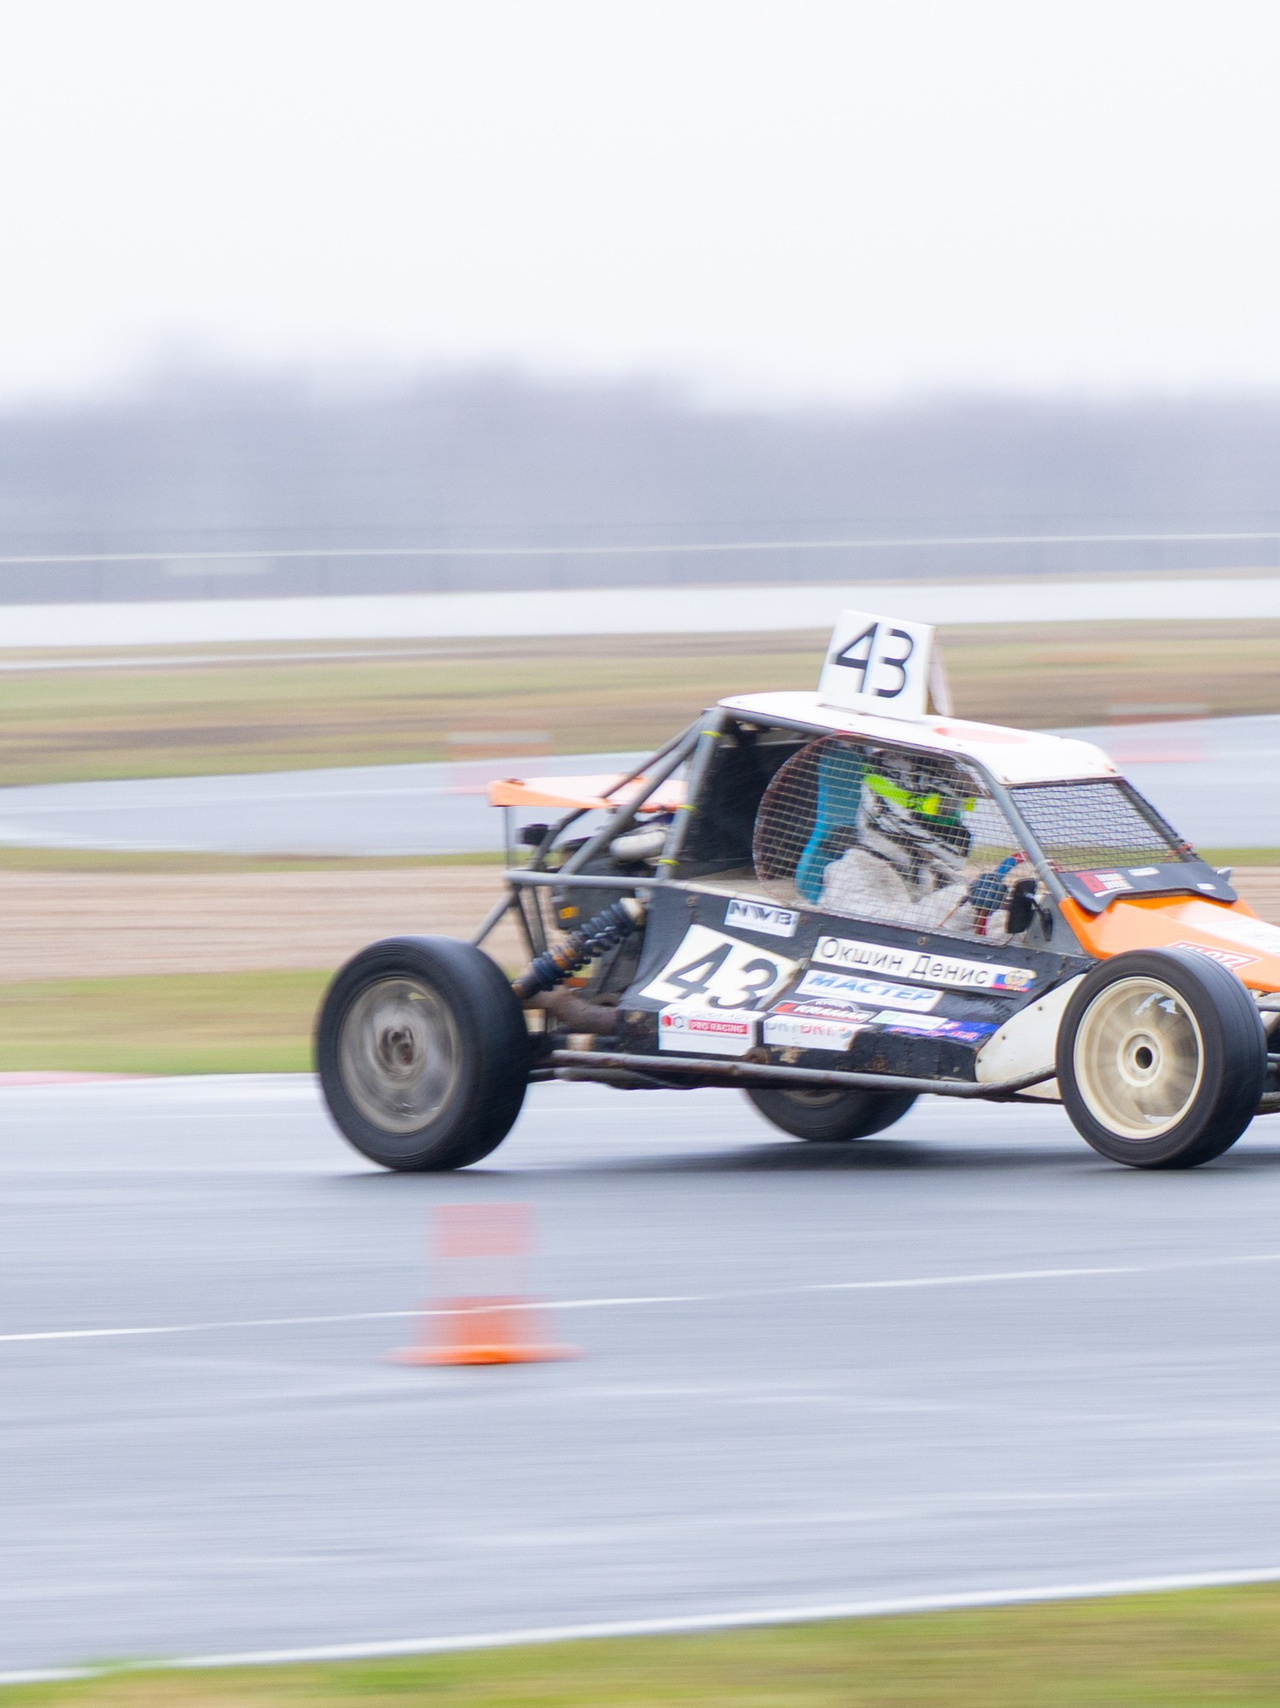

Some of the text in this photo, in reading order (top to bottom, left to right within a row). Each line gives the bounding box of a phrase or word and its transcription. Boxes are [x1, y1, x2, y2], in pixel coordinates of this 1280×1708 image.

[829, 622, 914, 698] 43
[662, 942, 778, 1008] 43
[819, 937, 990, 985] Окшин Денис
[807, 973, 939, 1001] МАСТЕР
[690, 1020, 744, 1034] PRO RACING
